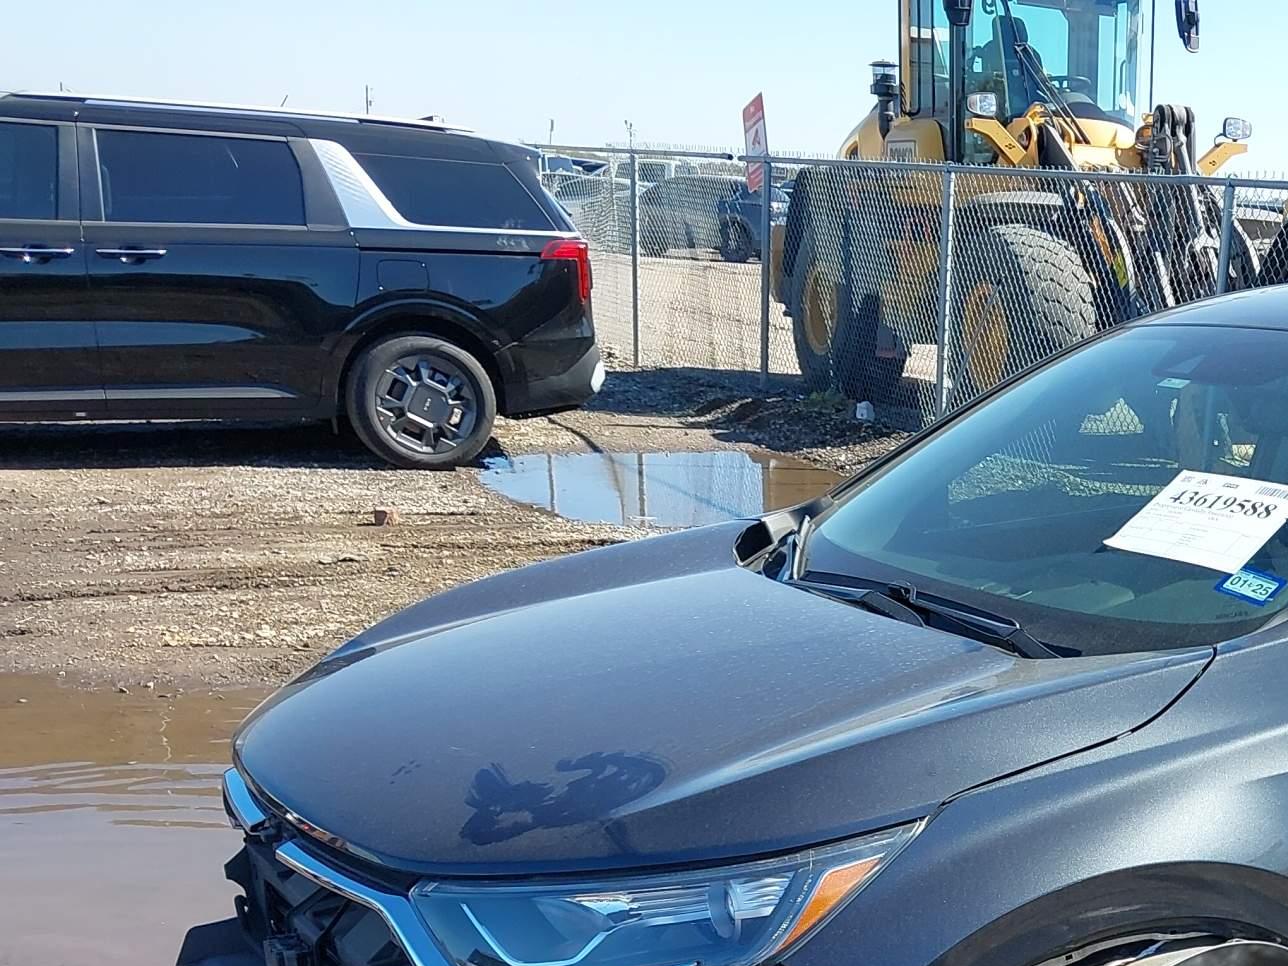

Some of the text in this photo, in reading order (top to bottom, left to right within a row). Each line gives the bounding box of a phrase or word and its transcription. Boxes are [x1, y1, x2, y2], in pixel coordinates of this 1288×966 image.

[1169, 489, 1278, 520] 43619588
[1230, 576, 1272, 597] 01 25
